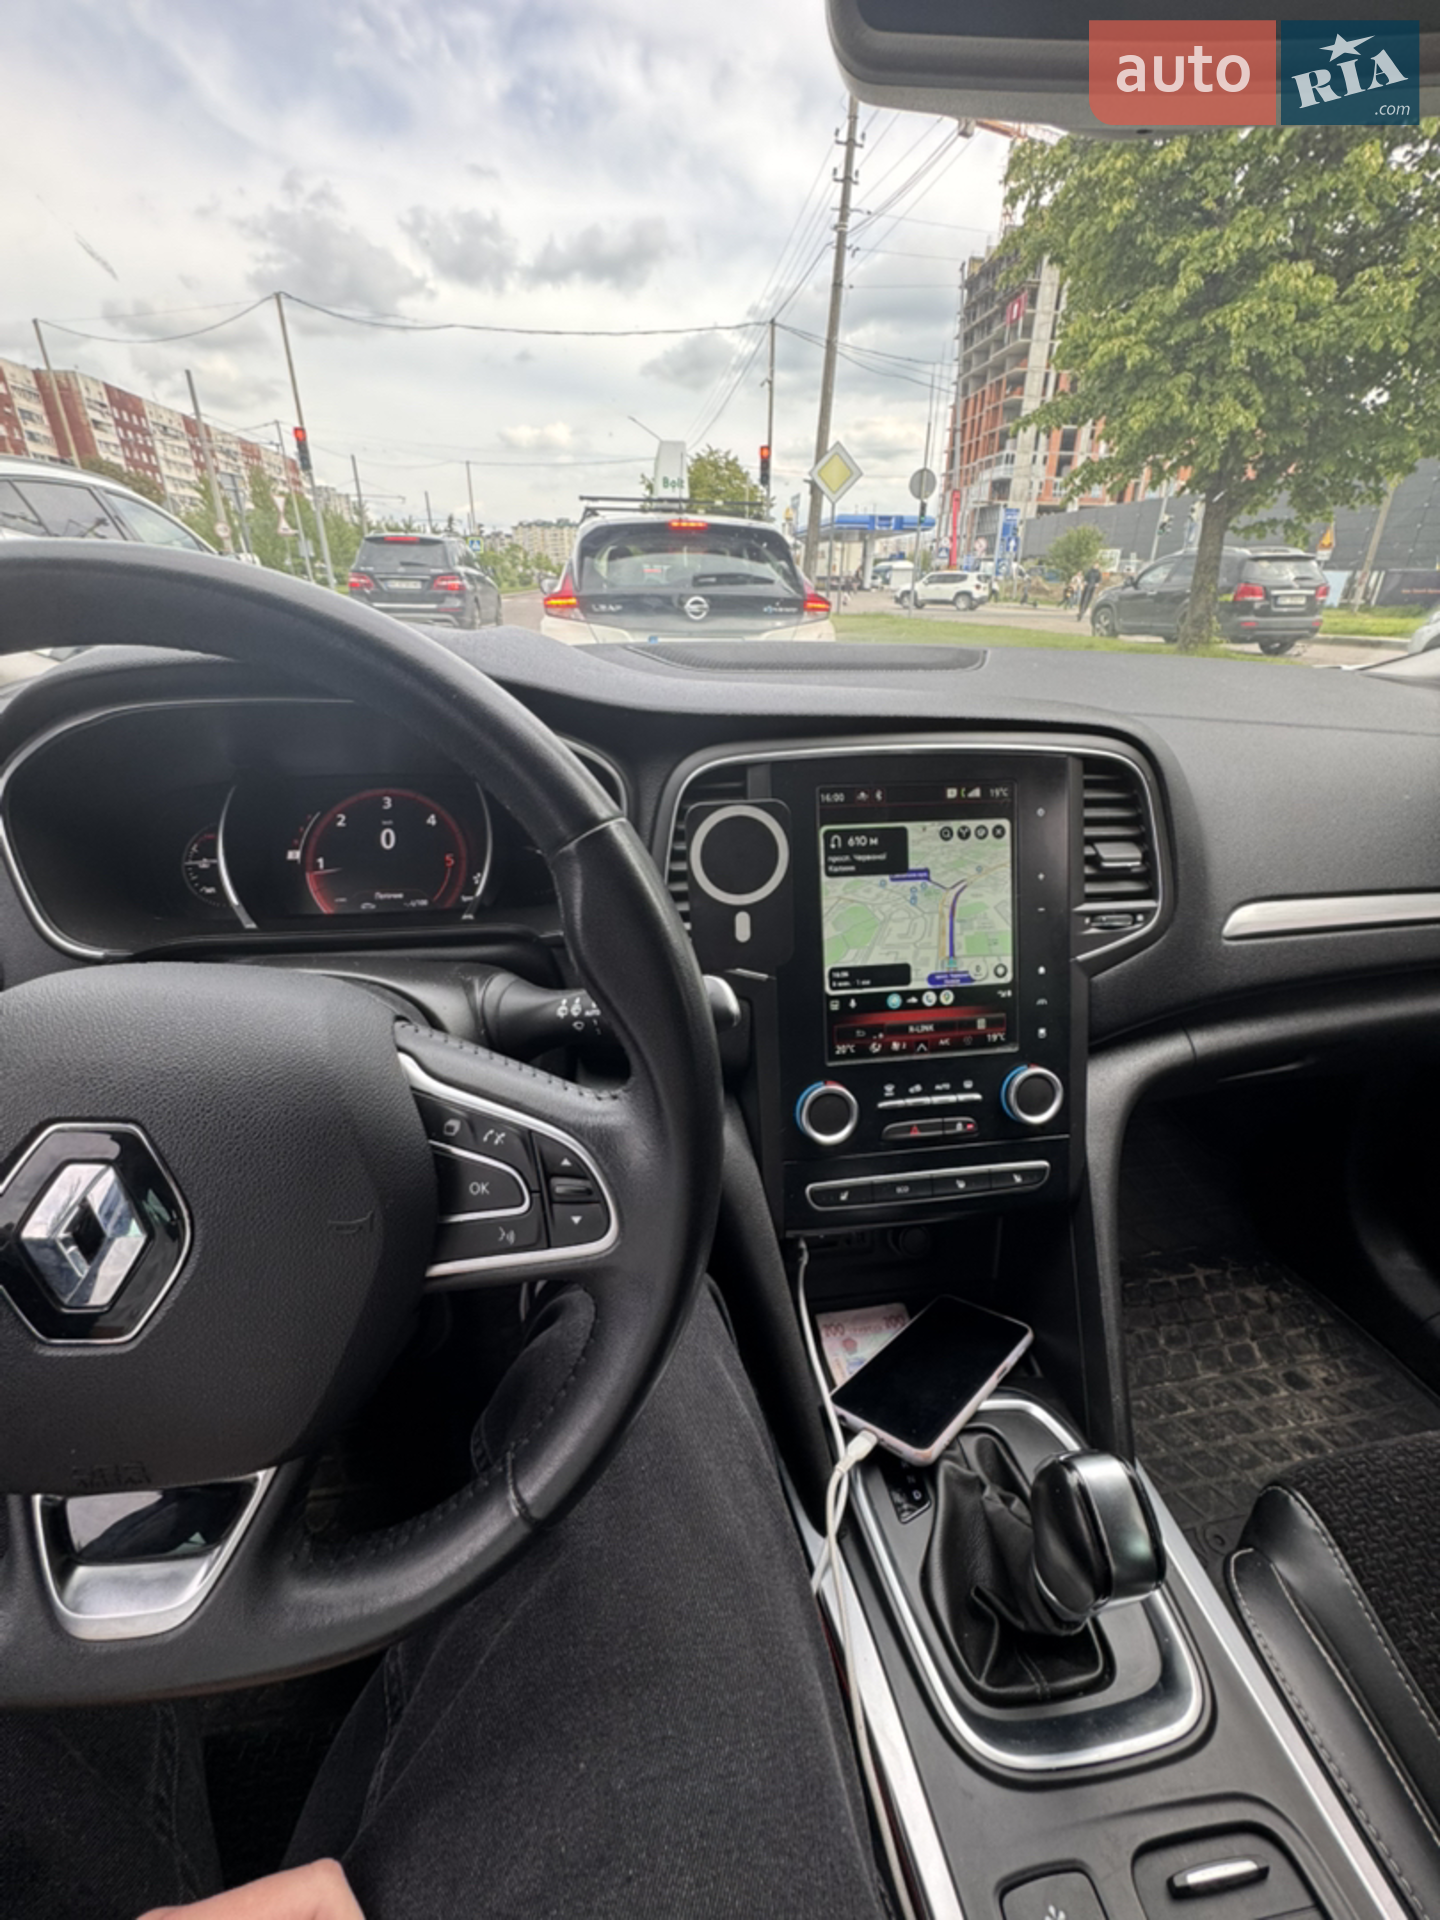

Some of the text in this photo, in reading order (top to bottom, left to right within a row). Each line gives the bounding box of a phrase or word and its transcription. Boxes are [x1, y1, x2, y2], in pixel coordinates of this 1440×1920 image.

[382, 796, 392, 810] 3
[821, 792, 845, 802] 16:00
[336, 813, 347, 827] 2
[426, 813, 437, 826] 4
[380, 827, 396, 850] 0
[847, 835, 868, 847] 610
[316, 857, 324, 870] 1
[444, 853, 455, 868] 5
[468, 1181, 490, 1196] OK
